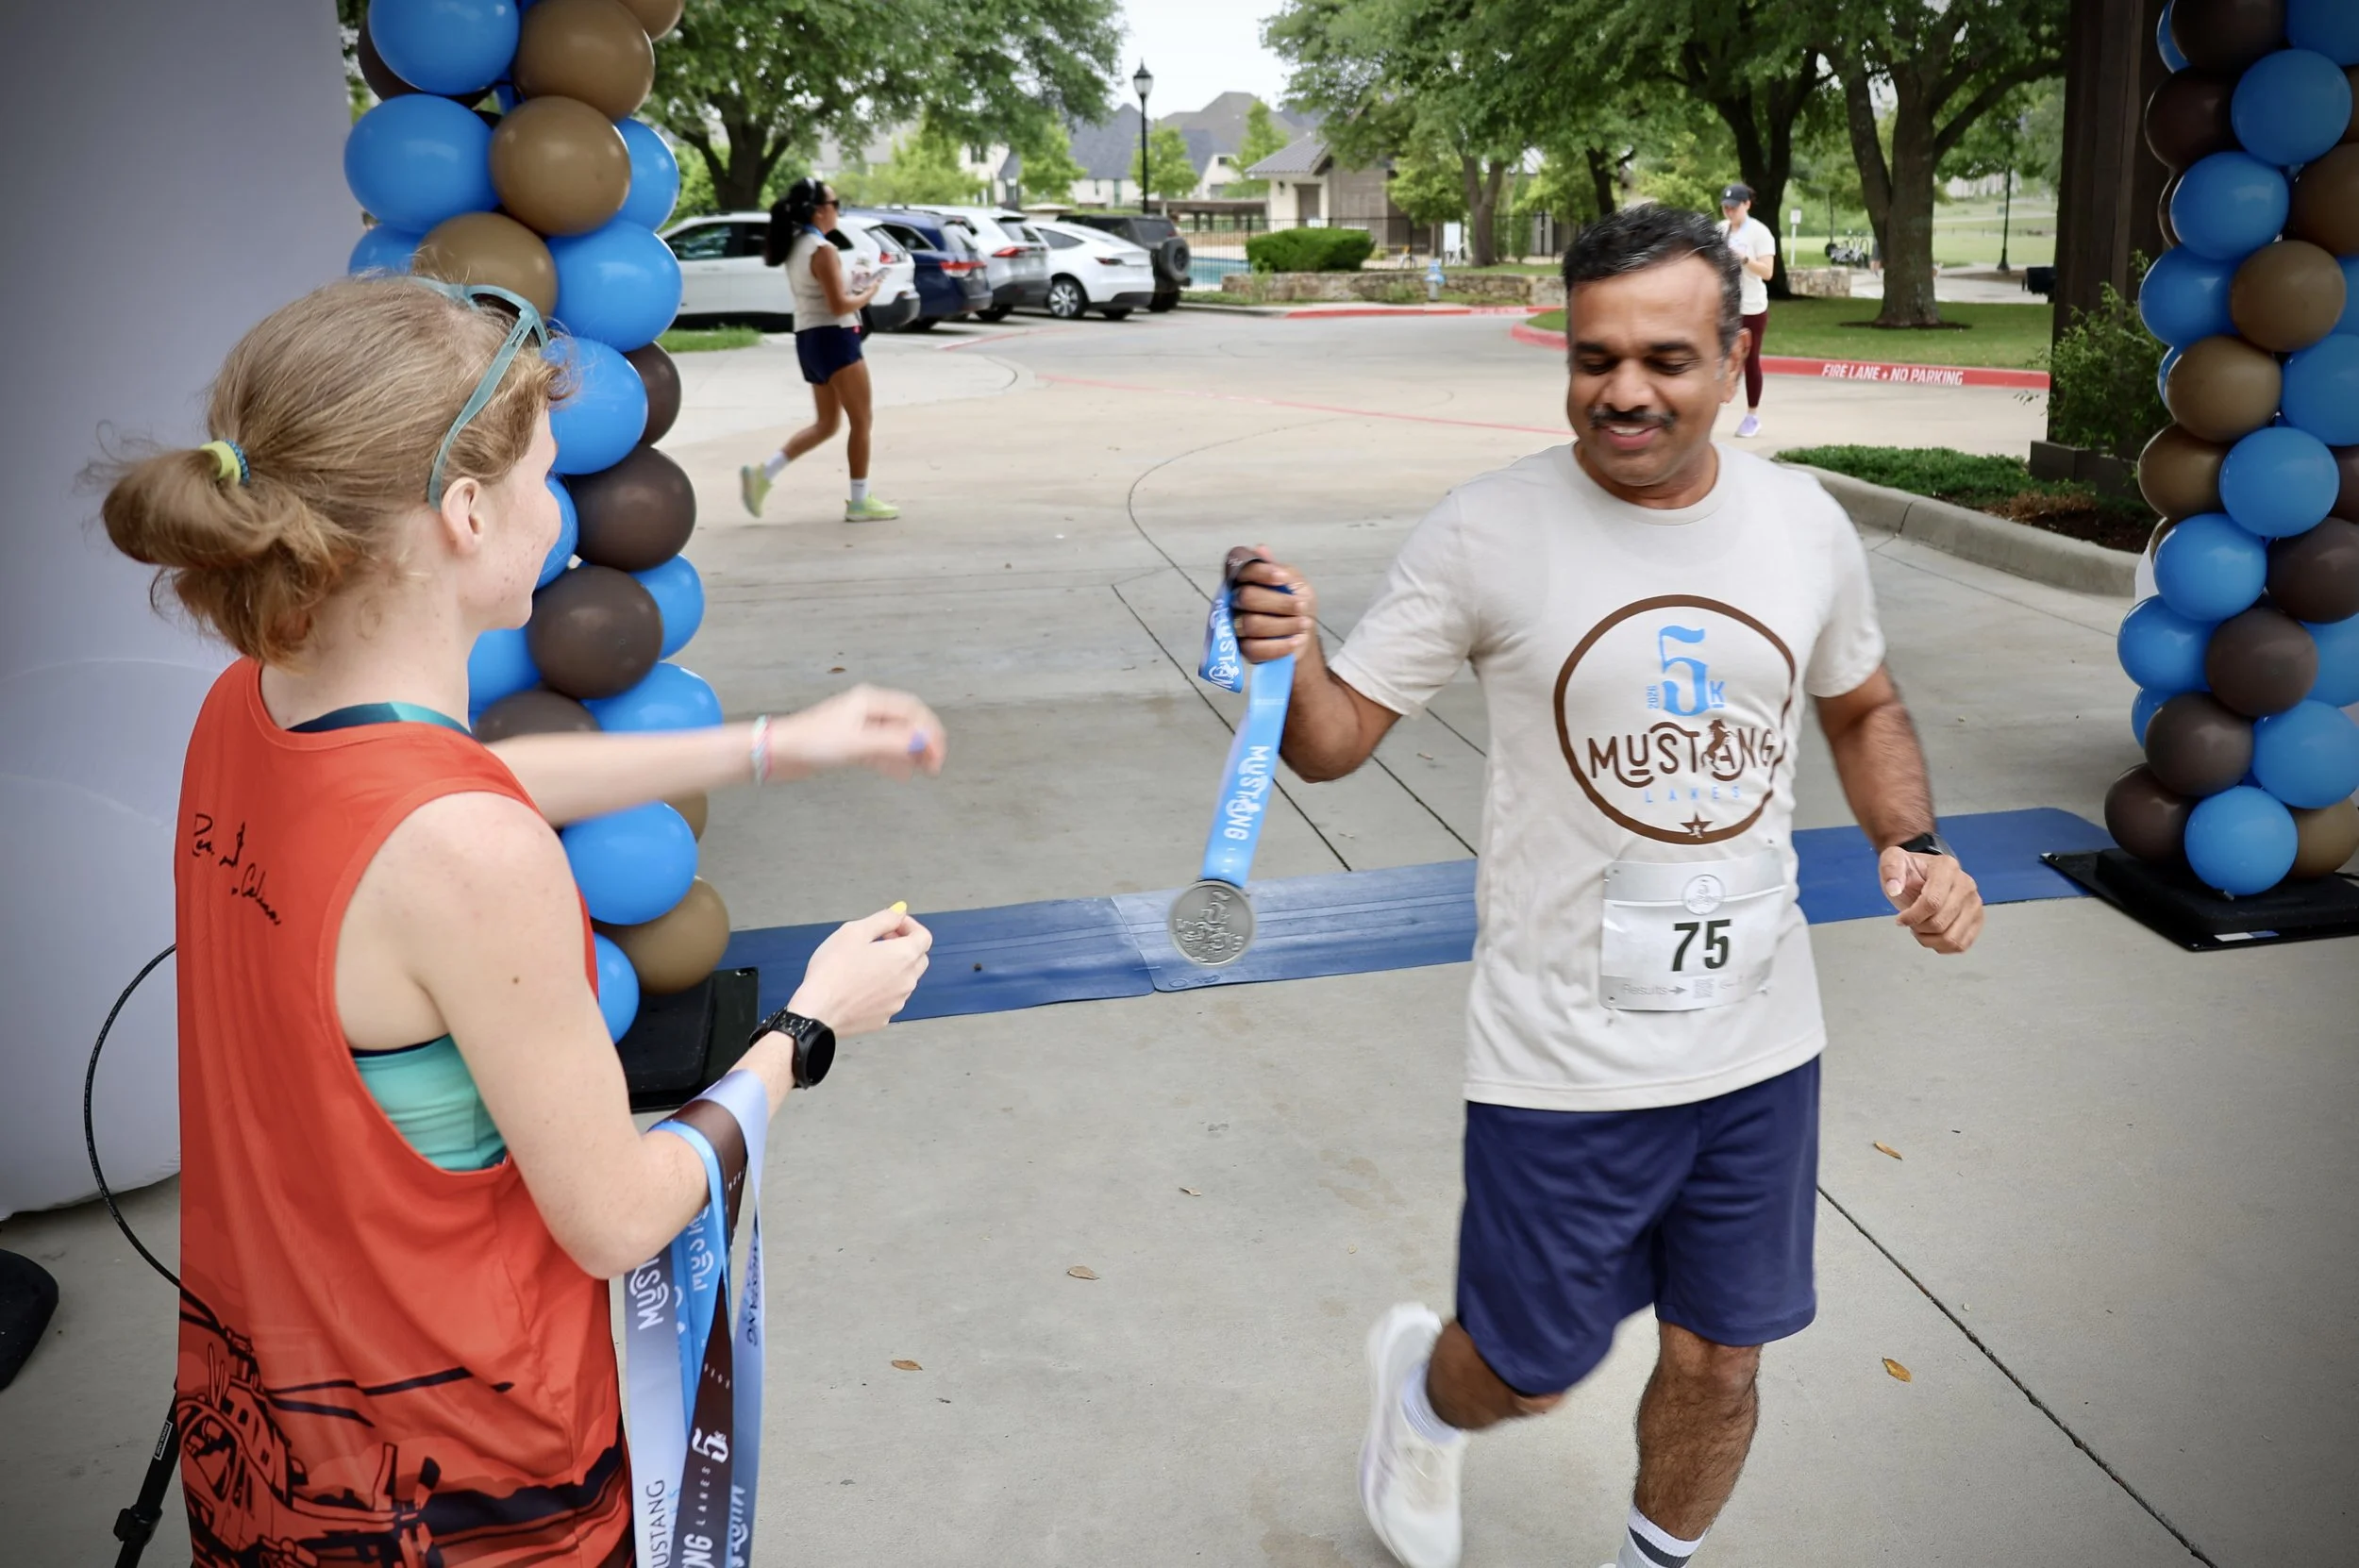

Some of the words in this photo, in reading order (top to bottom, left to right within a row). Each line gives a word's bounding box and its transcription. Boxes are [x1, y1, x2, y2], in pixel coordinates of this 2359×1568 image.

[1821, 363, 1849, 377] FIRE
[1849, 365, 1882, 380] LANE
[1890, 366, 1909, 381] NO
[1910, 368, 1964, 386] PARKING
[1587, 720, 1775, 789] MUSTANG
[1224, 744, 1271, 841] MUSTANG
[1645, 785, 1741, 803] LAKES
[1670, 918, 1732, 972] 75
[629, 1257, 669, 1330] MUST
[645, 1478, 670, 1568] USTANG
